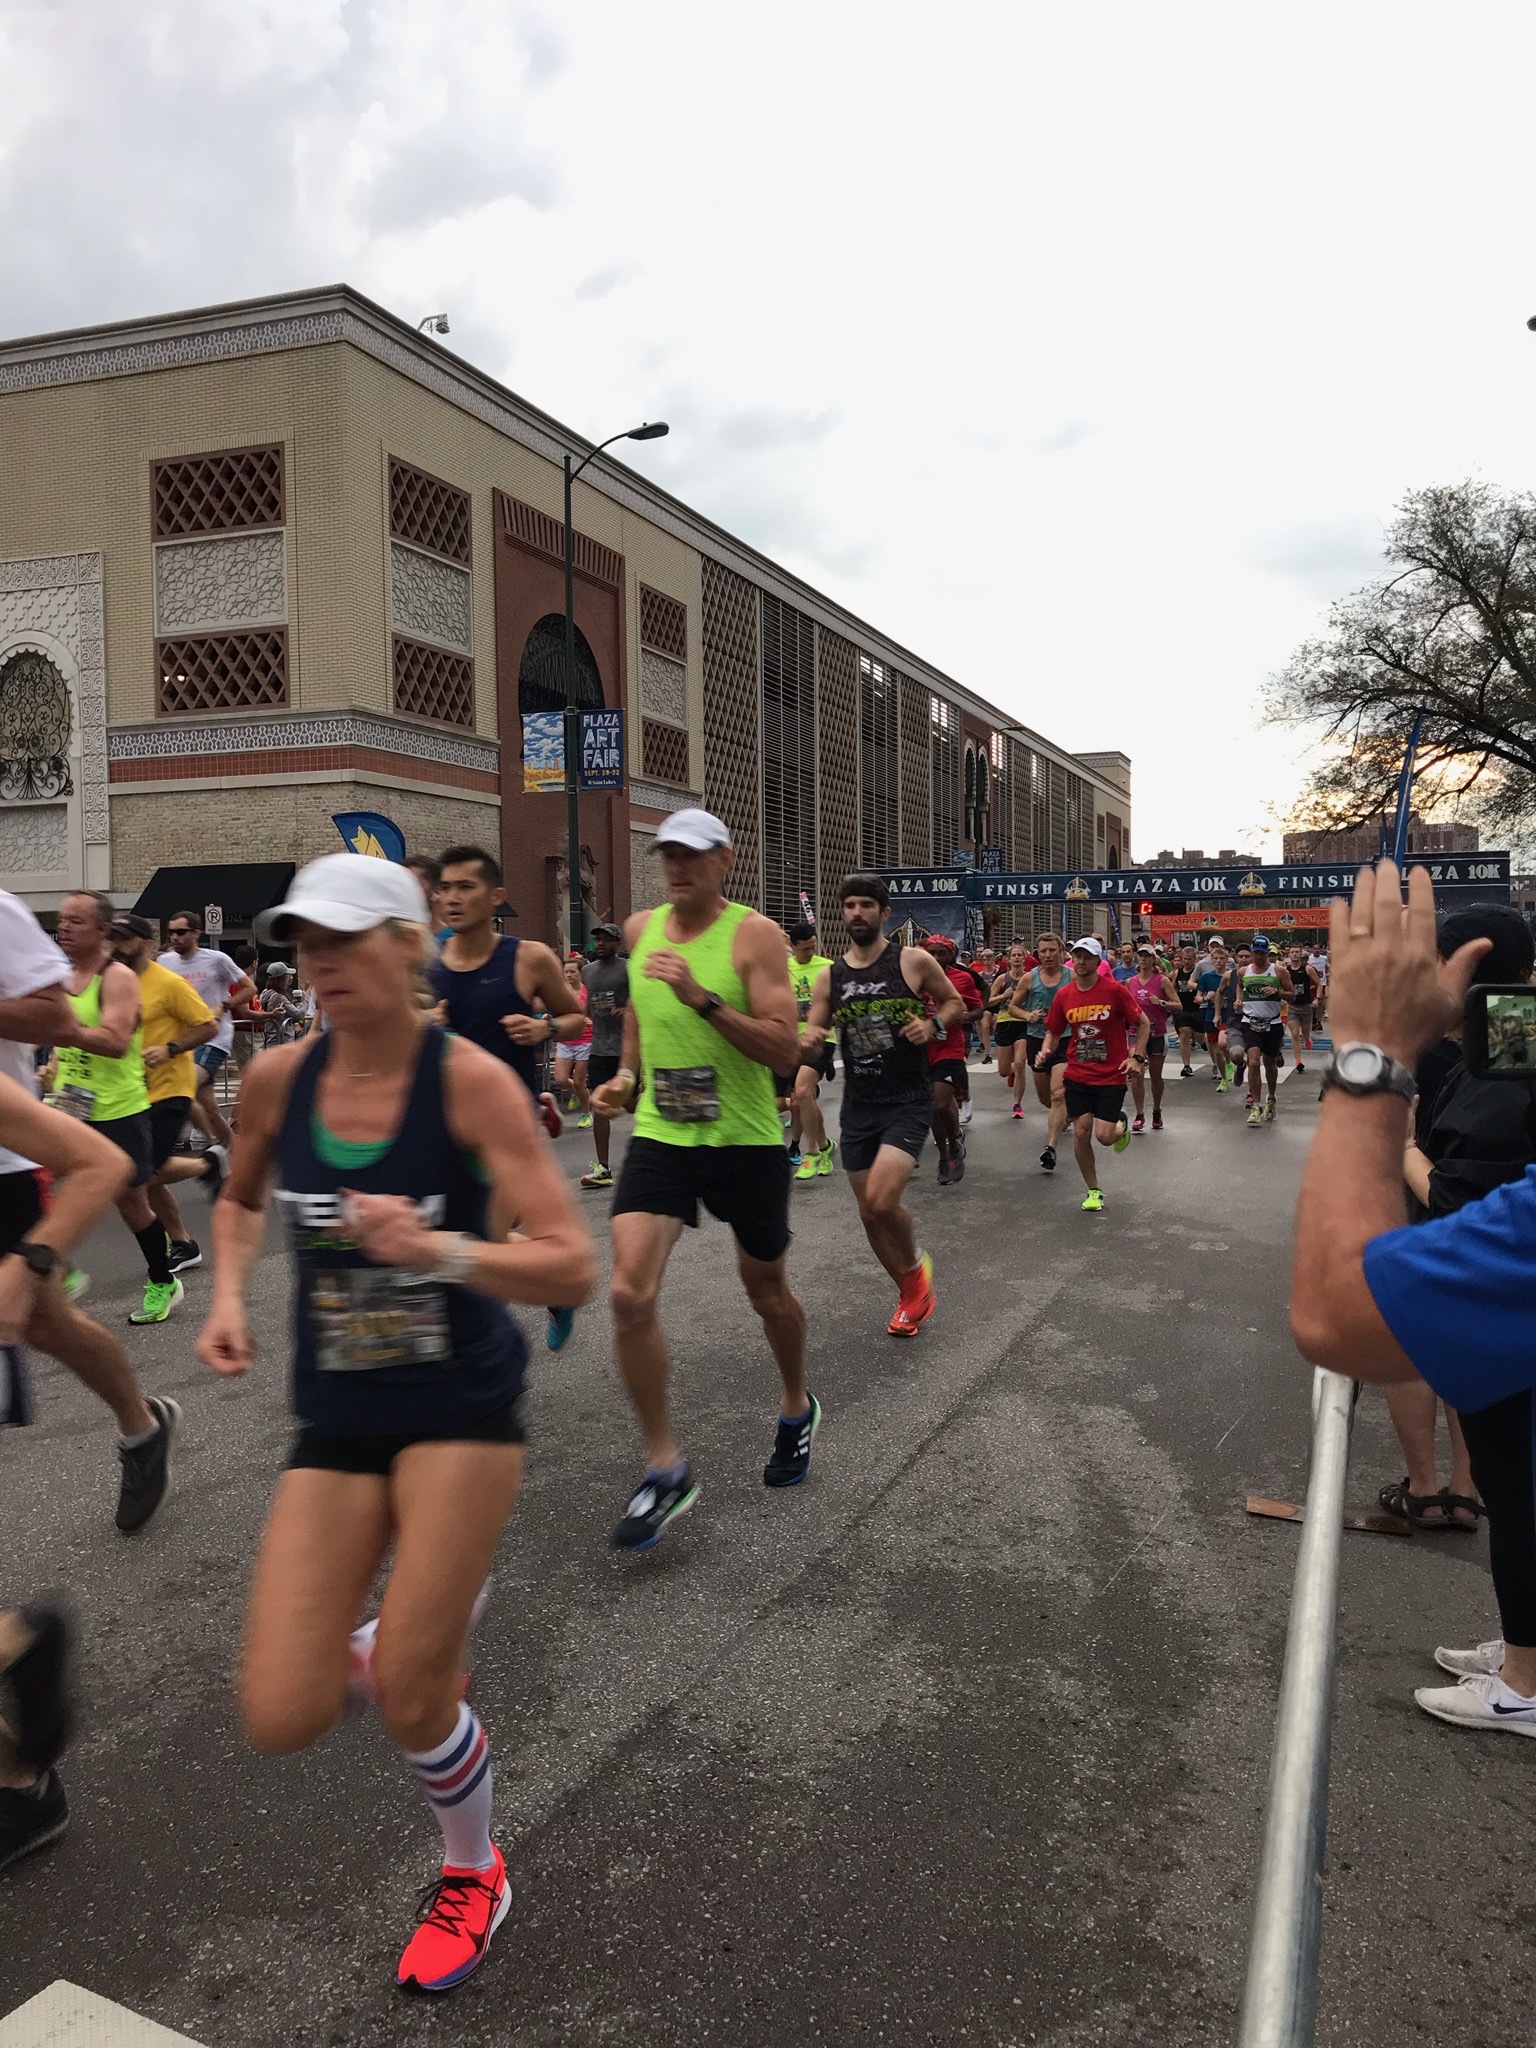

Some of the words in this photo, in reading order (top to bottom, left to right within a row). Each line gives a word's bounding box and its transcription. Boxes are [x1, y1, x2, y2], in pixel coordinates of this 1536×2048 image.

[583, 714, 619, 727] PLAZA
[584, 728, 620, 748] ART
[583, 749, 620, 768] FAIR
[1467, 864, 1500, 879] 10K
[889, 880, 925, 893] AZA
[932, 879, 959, 892] 10K
[985, 883, 1053, 896] FINISH
[1100, 878, 1181, 894] PLAZA
[1191, 877, 1227, 892] 10K
[1278, 874, 1354, 889] FINISH
[1066, 1005, 1111, 1023] CHIEFS
